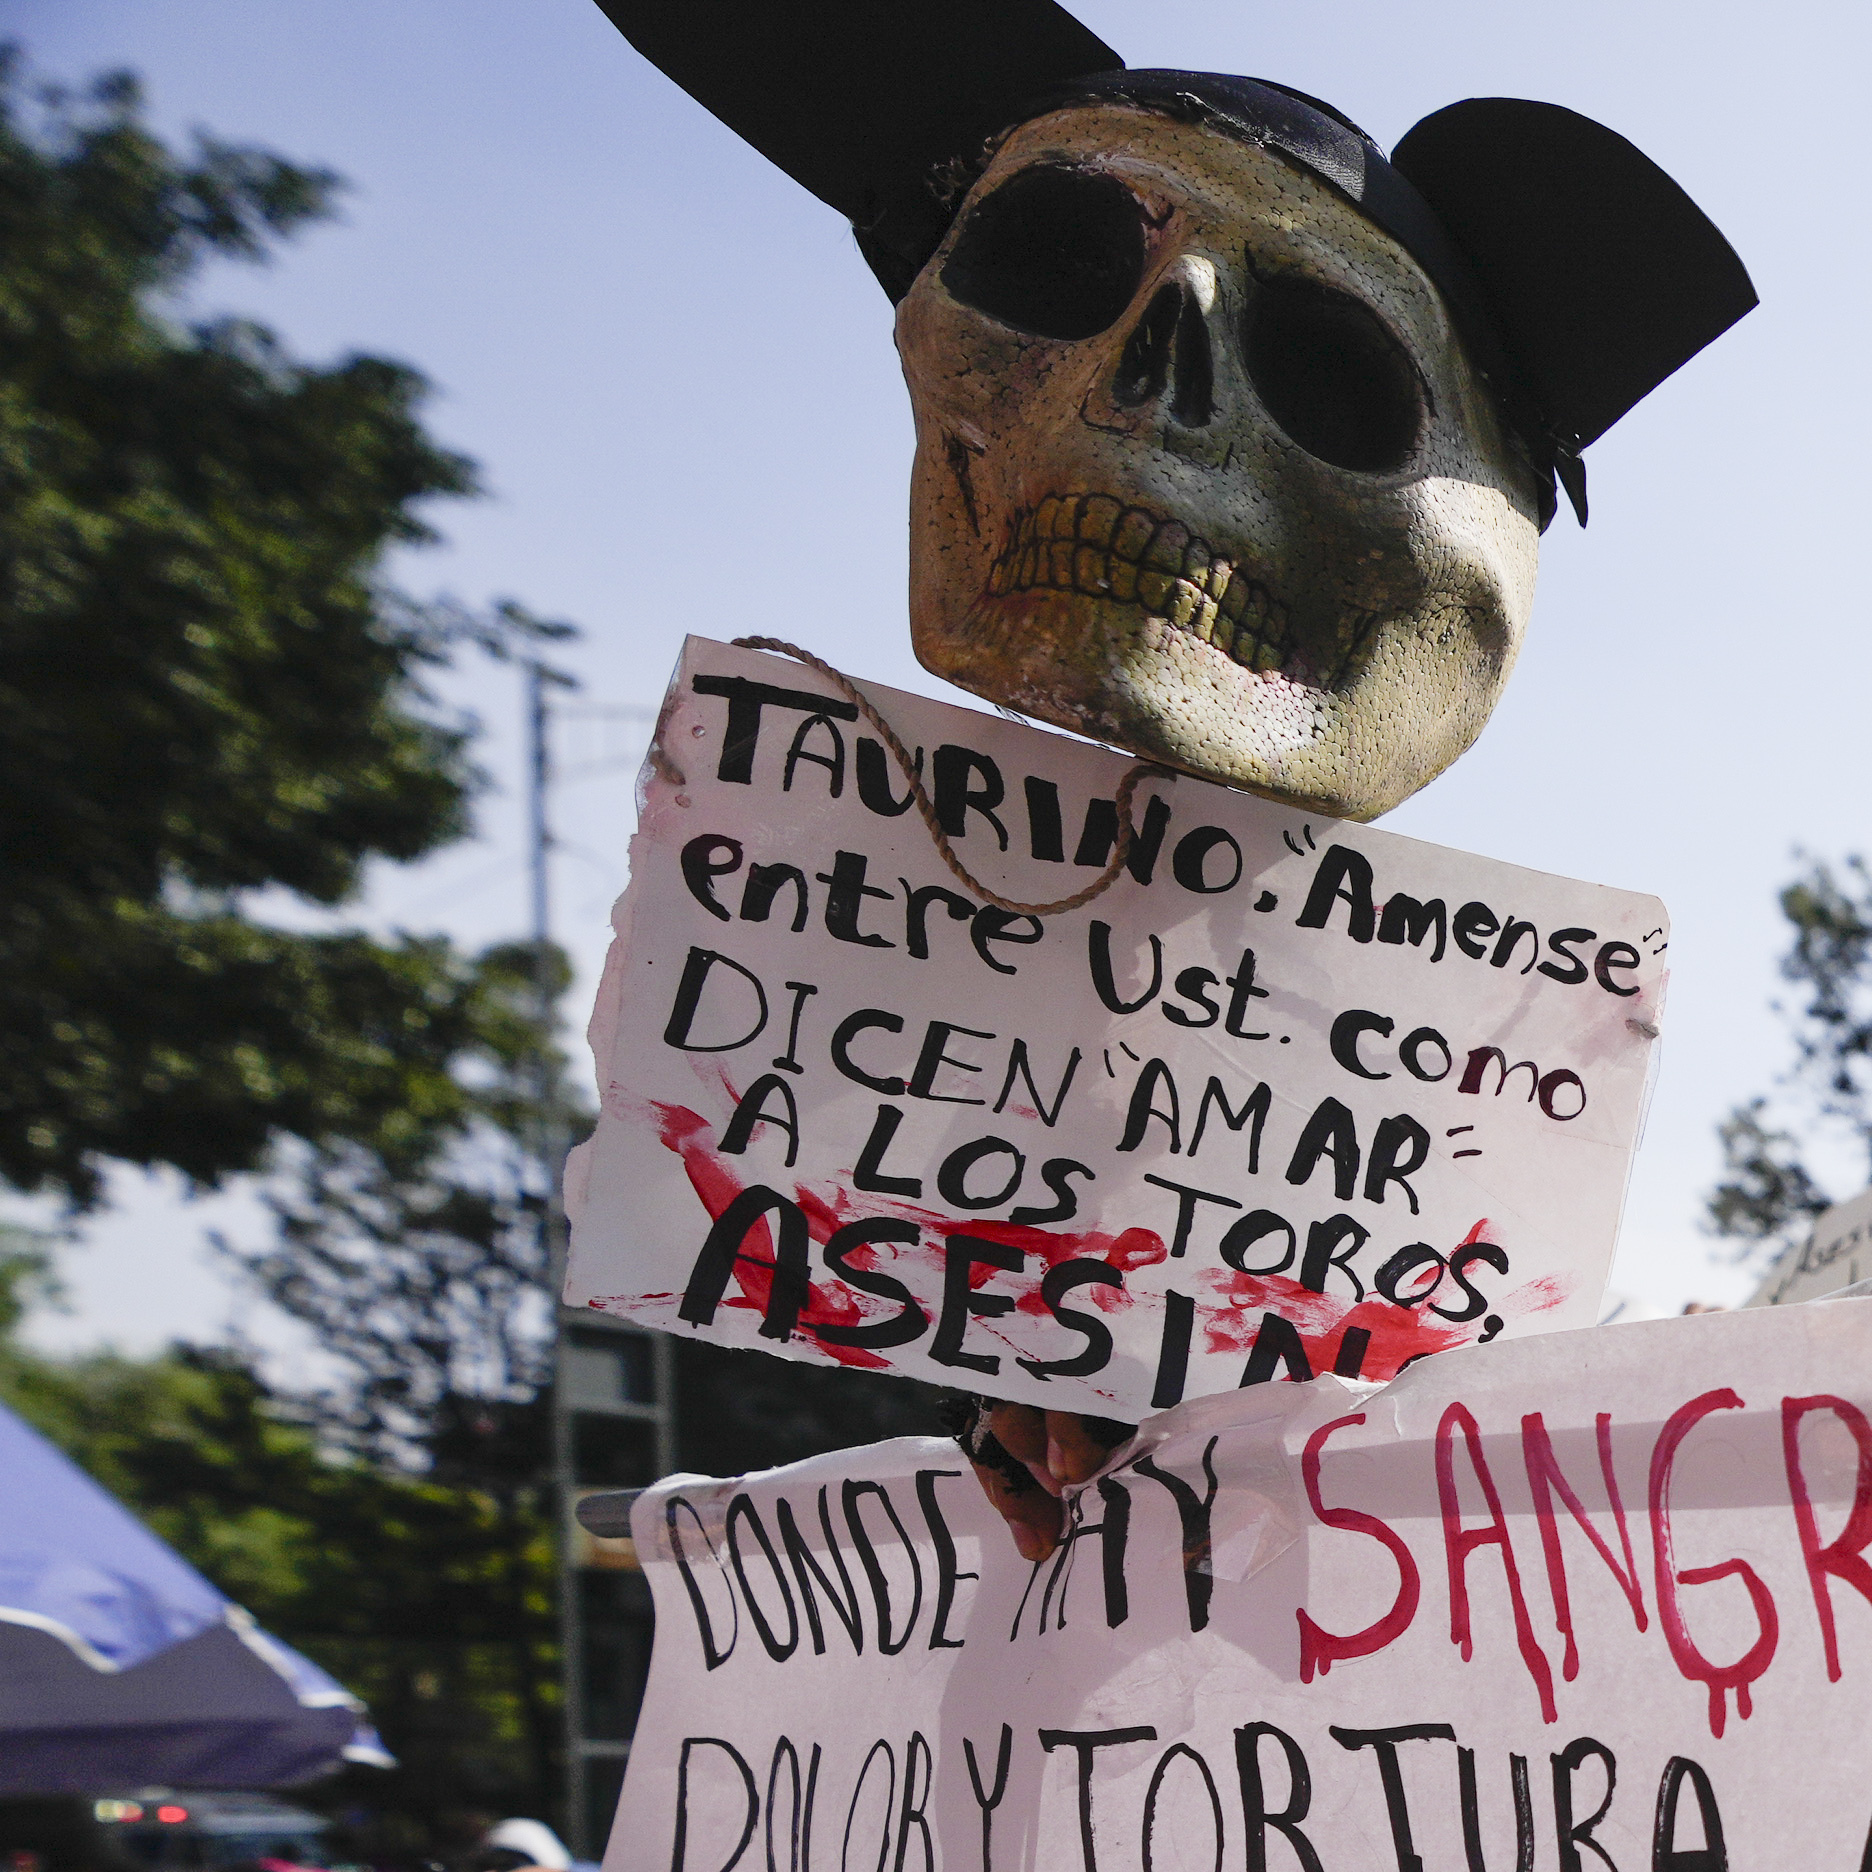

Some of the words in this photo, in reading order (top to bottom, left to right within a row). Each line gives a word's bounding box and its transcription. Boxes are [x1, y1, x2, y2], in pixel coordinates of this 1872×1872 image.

[662, 945, 1083, 1128] DICEN
[680, 832, 1043, 977] entre
[1088, 918, 1291, 1045] Ust.
[1330, 1006, 1588, 1121] como
[678, 1183, 1438, 1410] ASESIN
[717, 1071, 802, 1168] A
[852, 1101, 1095, 1225] LOS
[1144, 1170, 1510, 1345] TOROS,
[665, 1466, 982, 1672] DONDE
